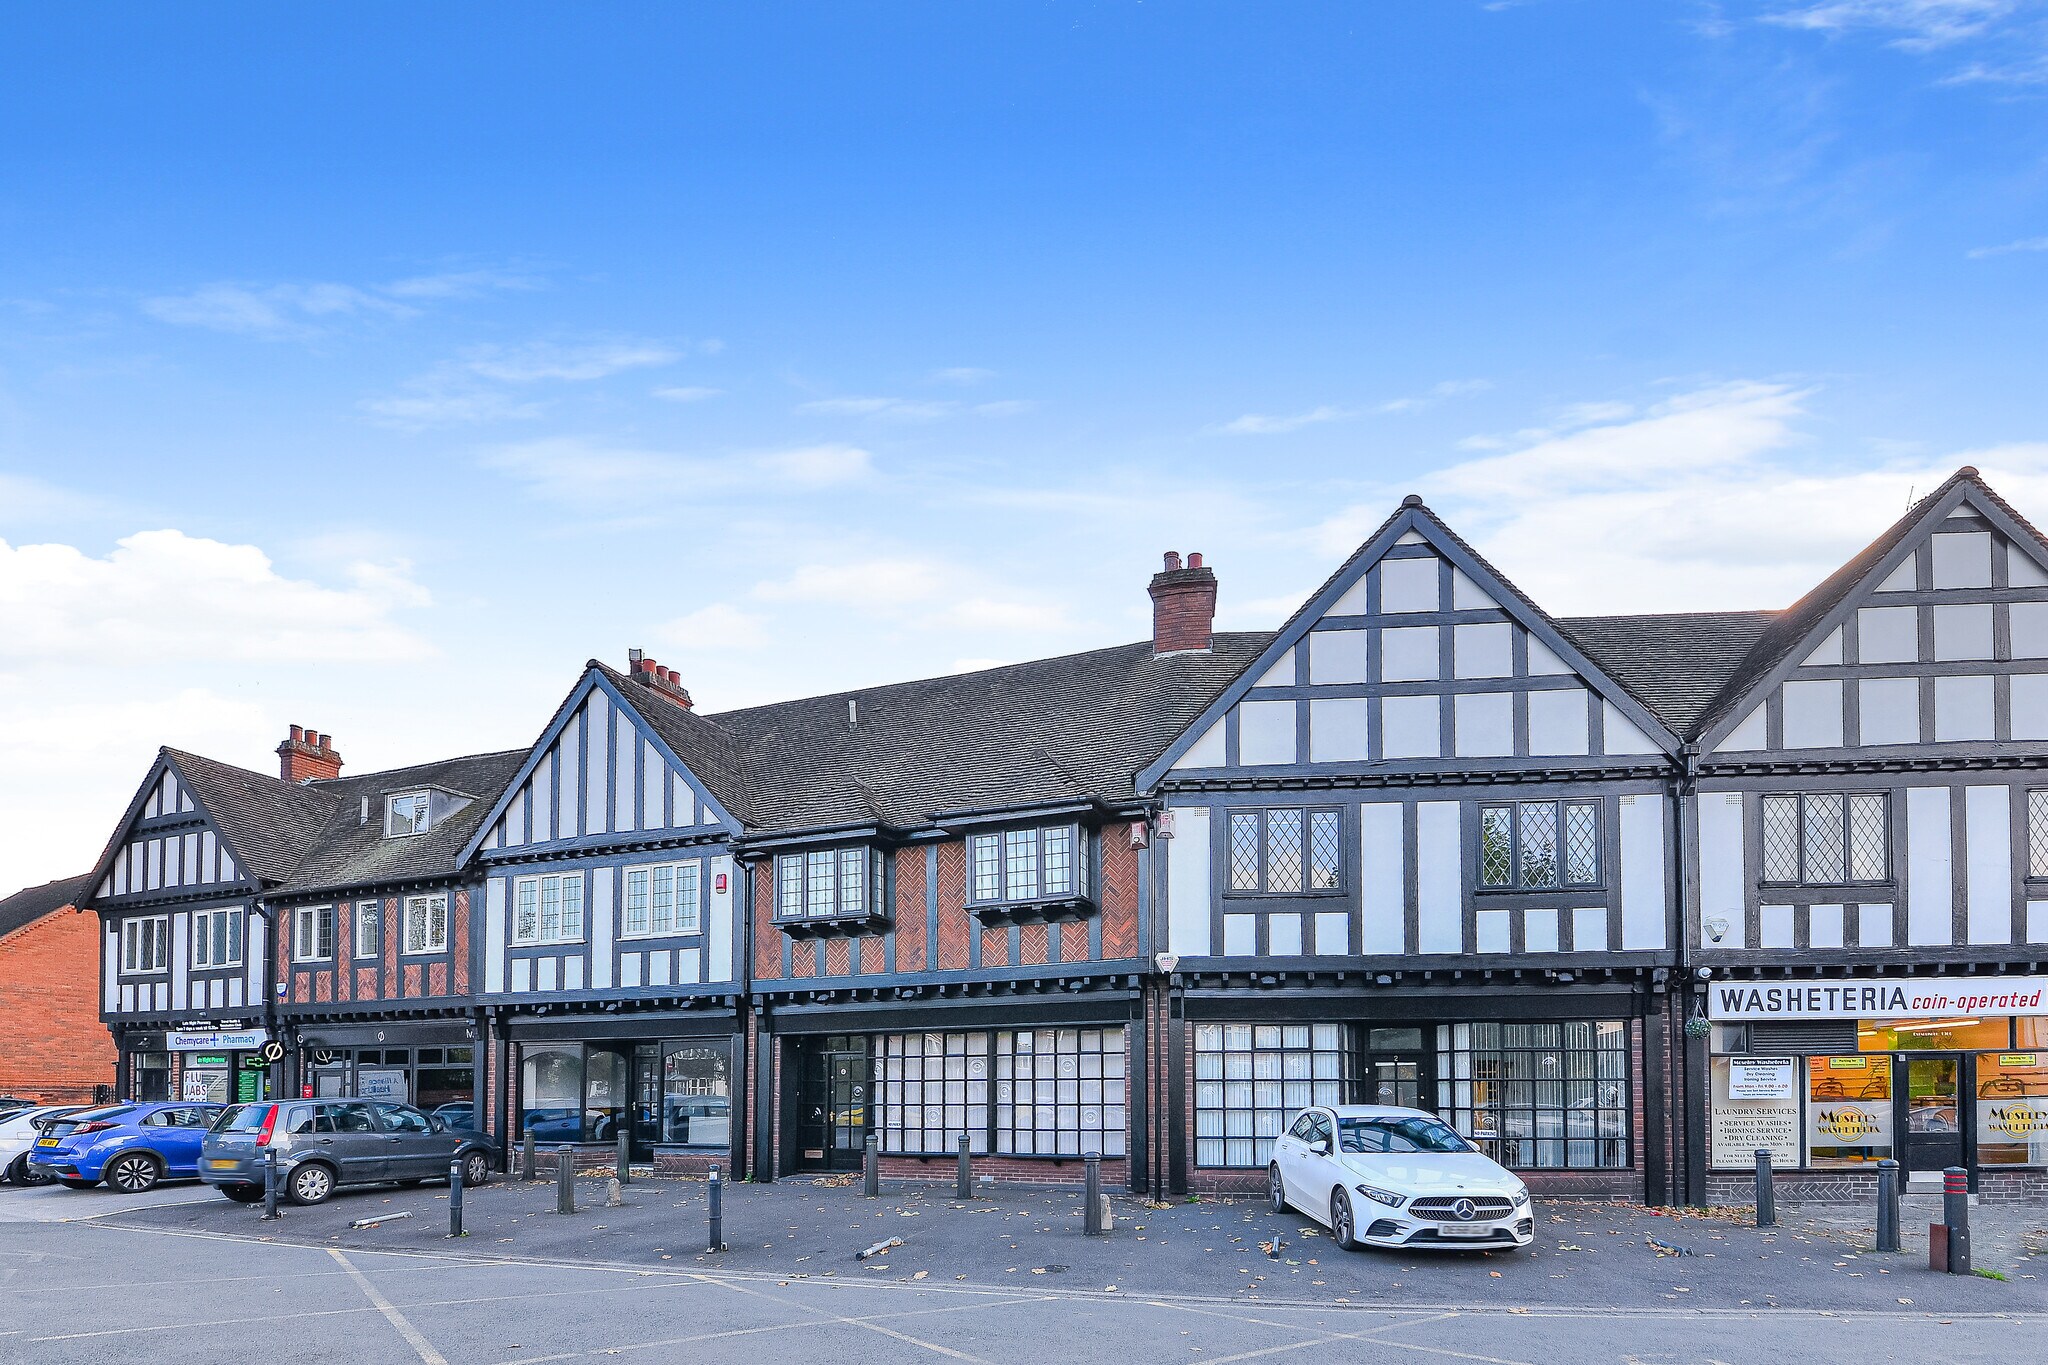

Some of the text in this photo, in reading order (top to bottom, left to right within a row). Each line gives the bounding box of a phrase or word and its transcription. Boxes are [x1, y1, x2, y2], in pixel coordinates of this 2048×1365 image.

[1721, 986, 2042, 1014] WASHETERIA coin-operated
[175, 1034, 256, 1047] Chemycare Pharmacy
[297, 1034, 304, 1044] C
[185, 1072, 202, 1083] FLU
[184, 1085, 207, 1096] JABS
[1756, 1107, 1797, 1115] SERVICES
